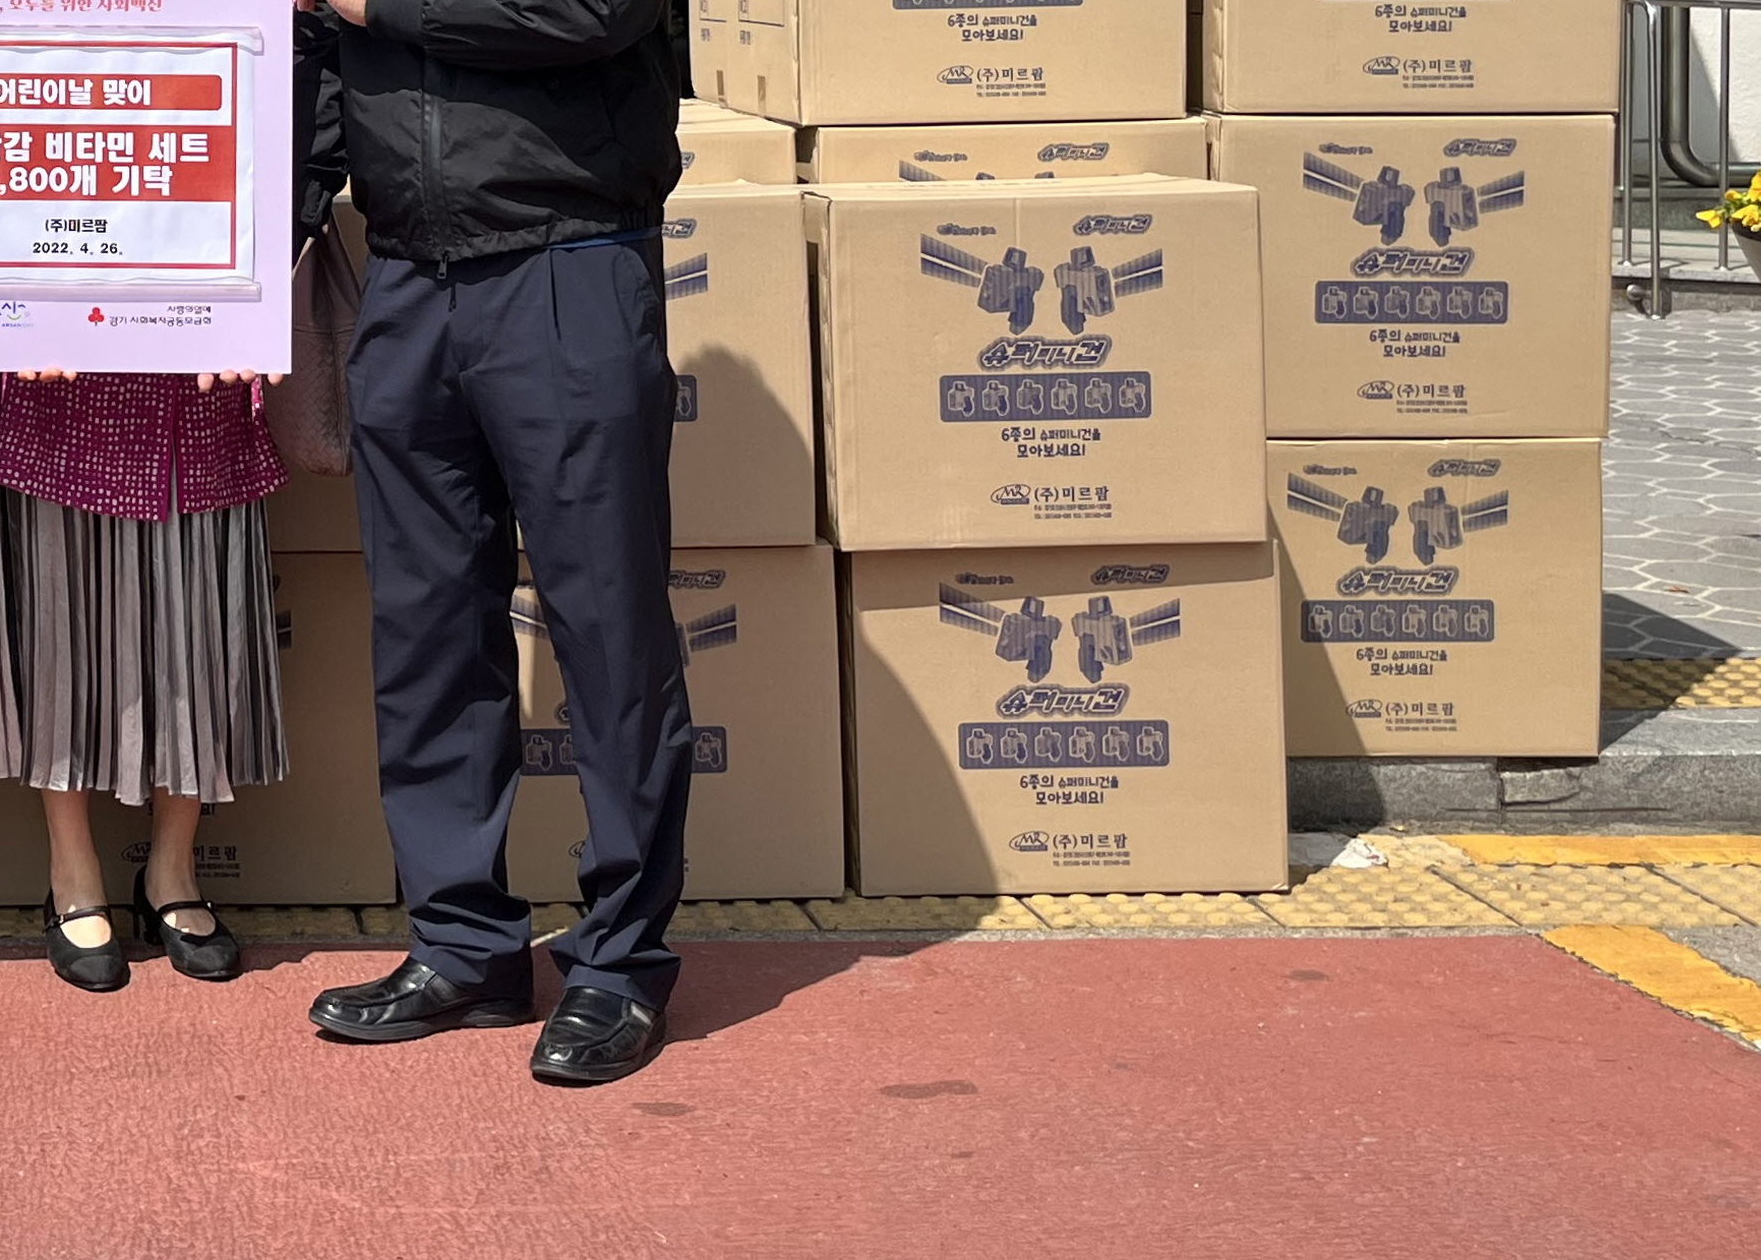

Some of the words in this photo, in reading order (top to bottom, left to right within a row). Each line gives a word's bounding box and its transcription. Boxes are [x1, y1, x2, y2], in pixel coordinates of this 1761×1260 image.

[1375, 5, 1407, 18] 6종의
[947, 13, 979, 28] 6종의
[1388, 20, 1452, 33] 모아보세요!
[962, 29, 1023, 42] 모아보세요!
[1403, 58, 1472, 74] (주)미르팜
[977, 67, 1044, 83] (주)미르팜
[103, 79, 152, 105] 맞이
[45, 131, 134, 163] 비타민
[149, 132, 210, 163] 세트
[112, 165, 173, 196] 기탁
[45, 219, 108, 233] (주)미르팜
[32, 242, 73, 255] 2022.
[80, 242, 94, 255] 4.
[100, 242, 123, 255] 26.
[1354, 251, 1470, 275] 슈퍼미니건
[1370, 330, 1402, 344] 6종의
[982, 339, 1109, 368] 슈퍼미니건
[1383, 344, 1446, 357] 모아보세요!
[1397, 384, 1465, 398] (주)미르팜
[1001, 427, 1036, 442] 6종의
[1017, 443, 1086, 458] 모아보세요!
[1034, 486, 1109, 503] (주)미르팜
[1341, 570, 1454, 594] 슈퍼미니건
[1356, 648, 1388, 661] 6종의
[1370, 663, 1433, 676] 모아보세요!
[1000, 686, 1127, 714] 슈퍼미니건
[1385, 702, 1454, 716] (주)미르팜
[1020, 774, 1054, 790] 6종의
[1036, 791, 1104, 805] 모아보세요!
[1053, 834, 1127, 850] (주)미르팜
